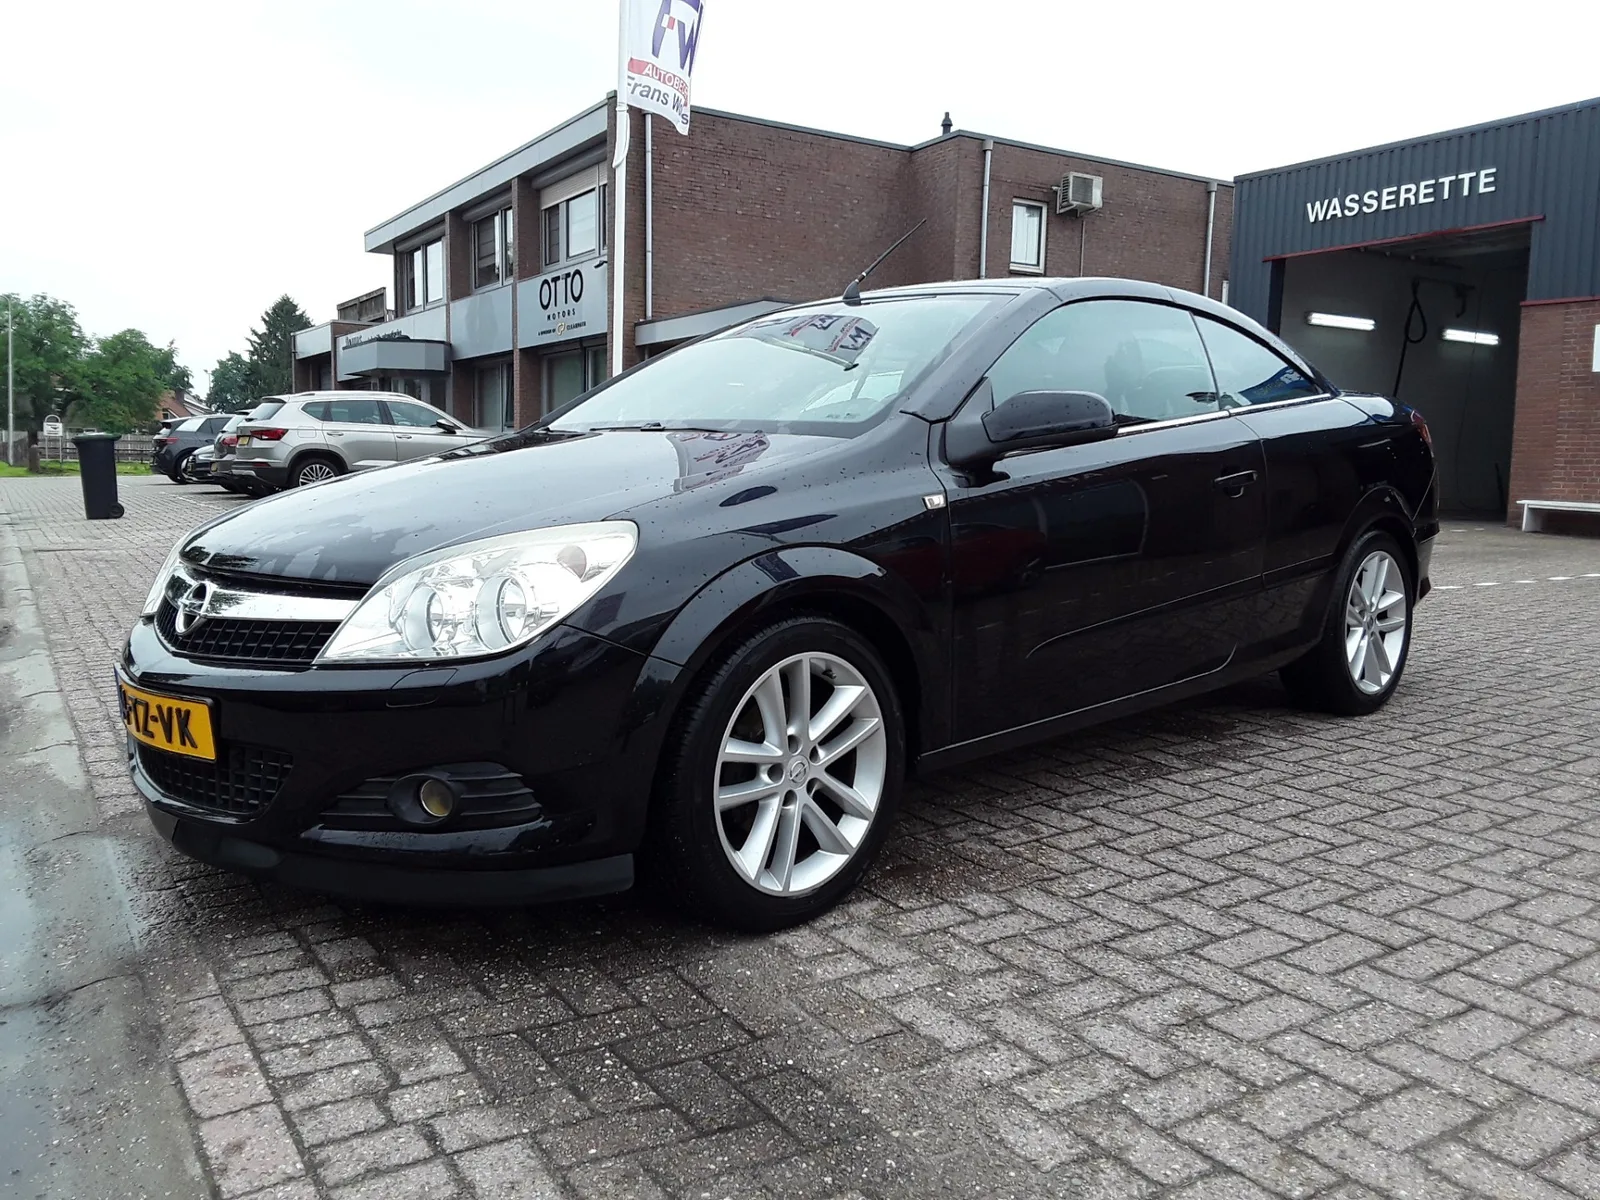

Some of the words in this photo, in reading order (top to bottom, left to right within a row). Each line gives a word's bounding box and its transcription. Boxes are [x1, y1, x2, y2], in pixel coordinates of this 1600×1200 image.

[1306, 167, 1497, 223] WASSERETTE
[539, 268, 584, 311] OTTO
[546, 308, 576, 321] MOTORS
